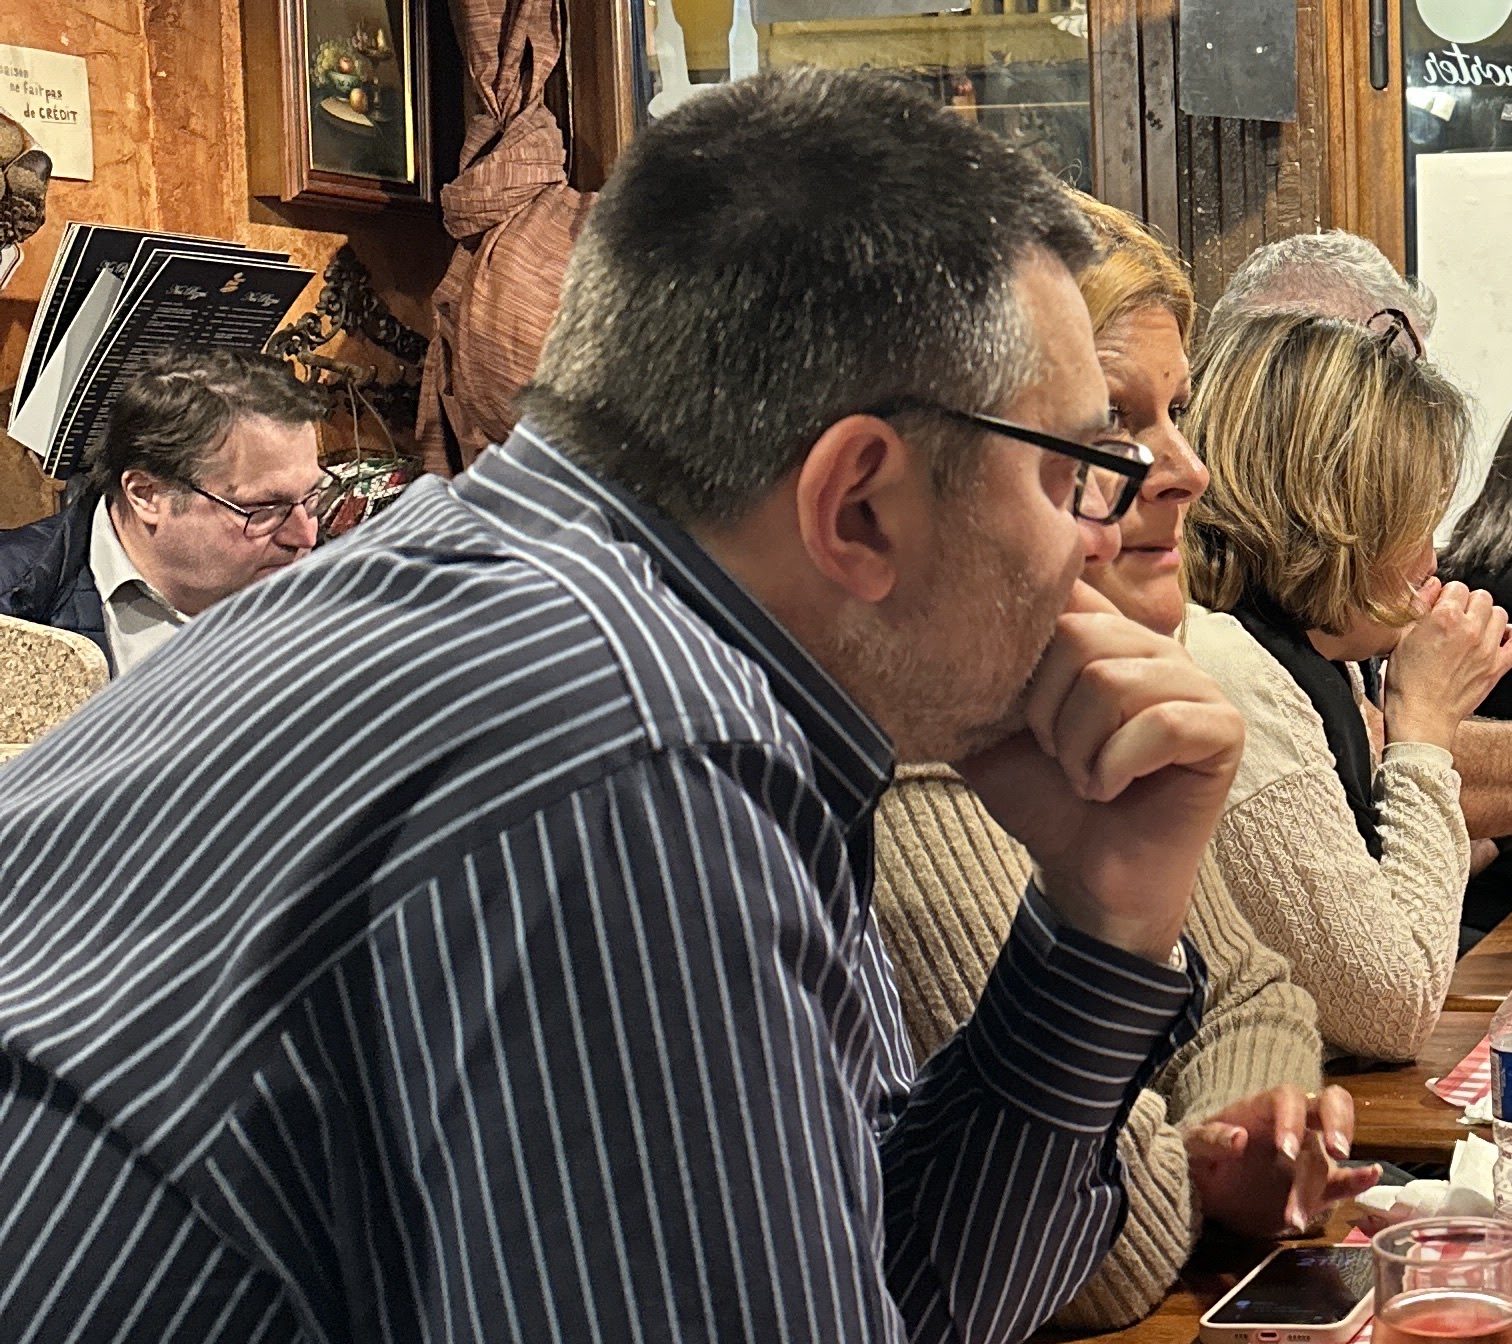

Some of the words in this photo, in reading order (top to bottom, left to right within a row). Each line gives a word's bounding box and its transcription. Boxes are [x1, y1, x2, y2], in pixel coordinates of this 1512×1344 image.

[0, 64, 29, 79] aison
[45, 88, 62, 104] pas
[23, 103, 36, 119] de
[39, 104, 78, 122] CRÉDIT
